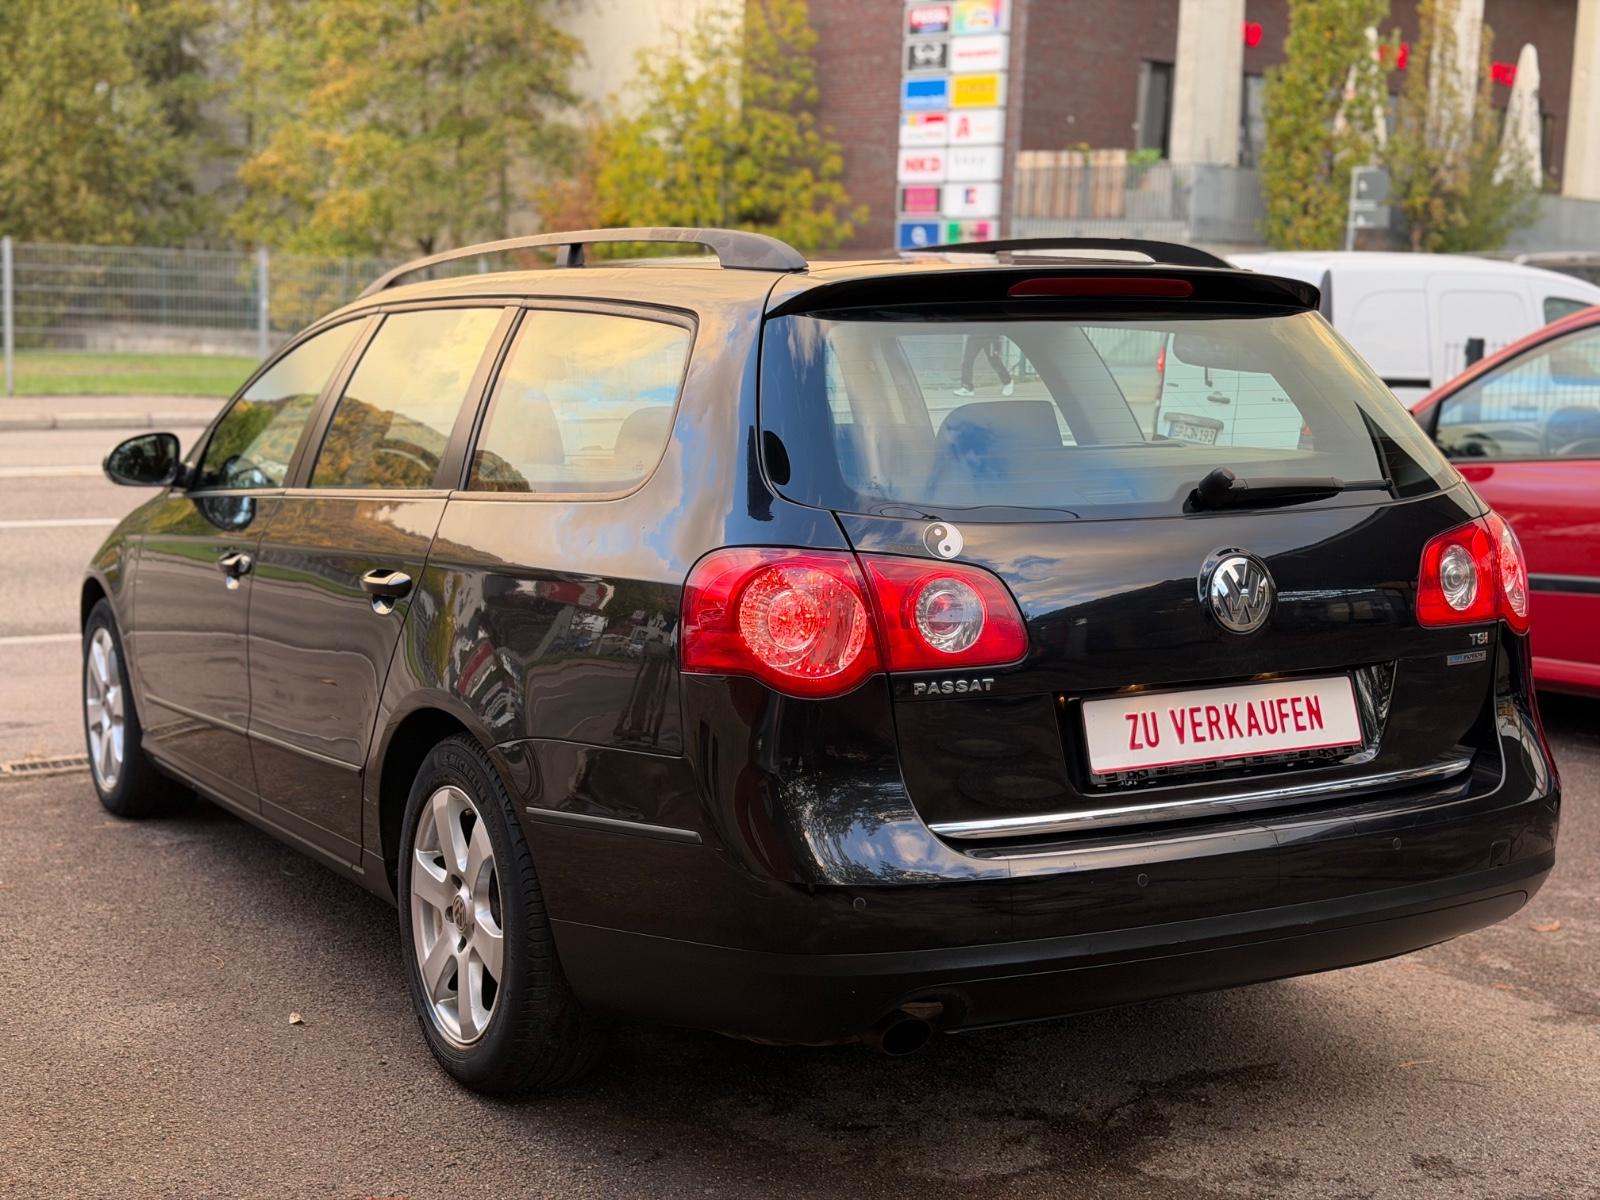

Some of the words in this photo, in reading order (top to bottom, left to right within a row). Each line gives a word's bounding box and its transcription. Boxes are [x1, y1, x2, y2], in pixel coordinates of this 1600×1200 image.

[1469, 631, 1489, 645] TSI
[912, 678, 994, 696] PASSAT
[1125, 711, 1160, 750] ZU
[1169, 695, 1324, 744] VERKAUFEN
